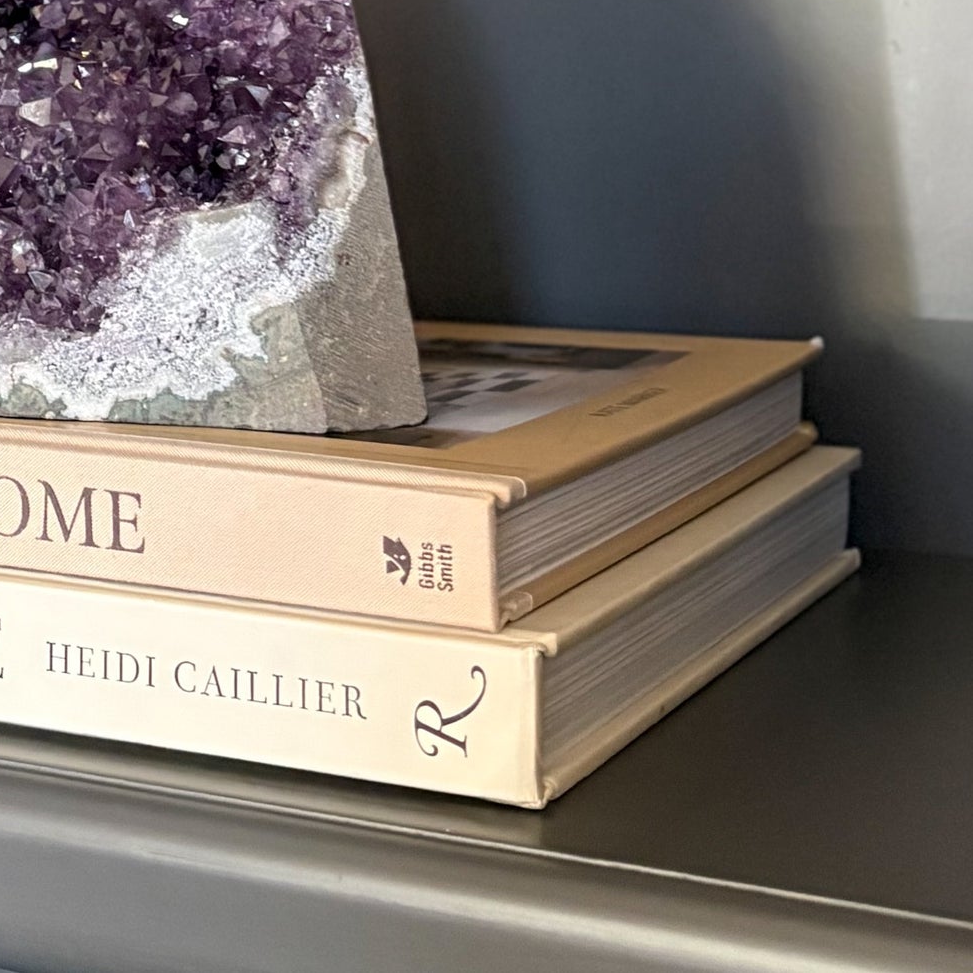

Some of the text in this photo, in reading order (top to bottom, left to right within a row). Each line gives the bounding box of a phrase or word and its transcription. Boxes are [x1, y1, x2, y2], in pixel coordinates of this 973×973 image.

[418, 542, 435, 589] Gibbs
[436, 544, 454, 592] Smith
[45, 641, 367, 720] HEIDI CAILLIER
